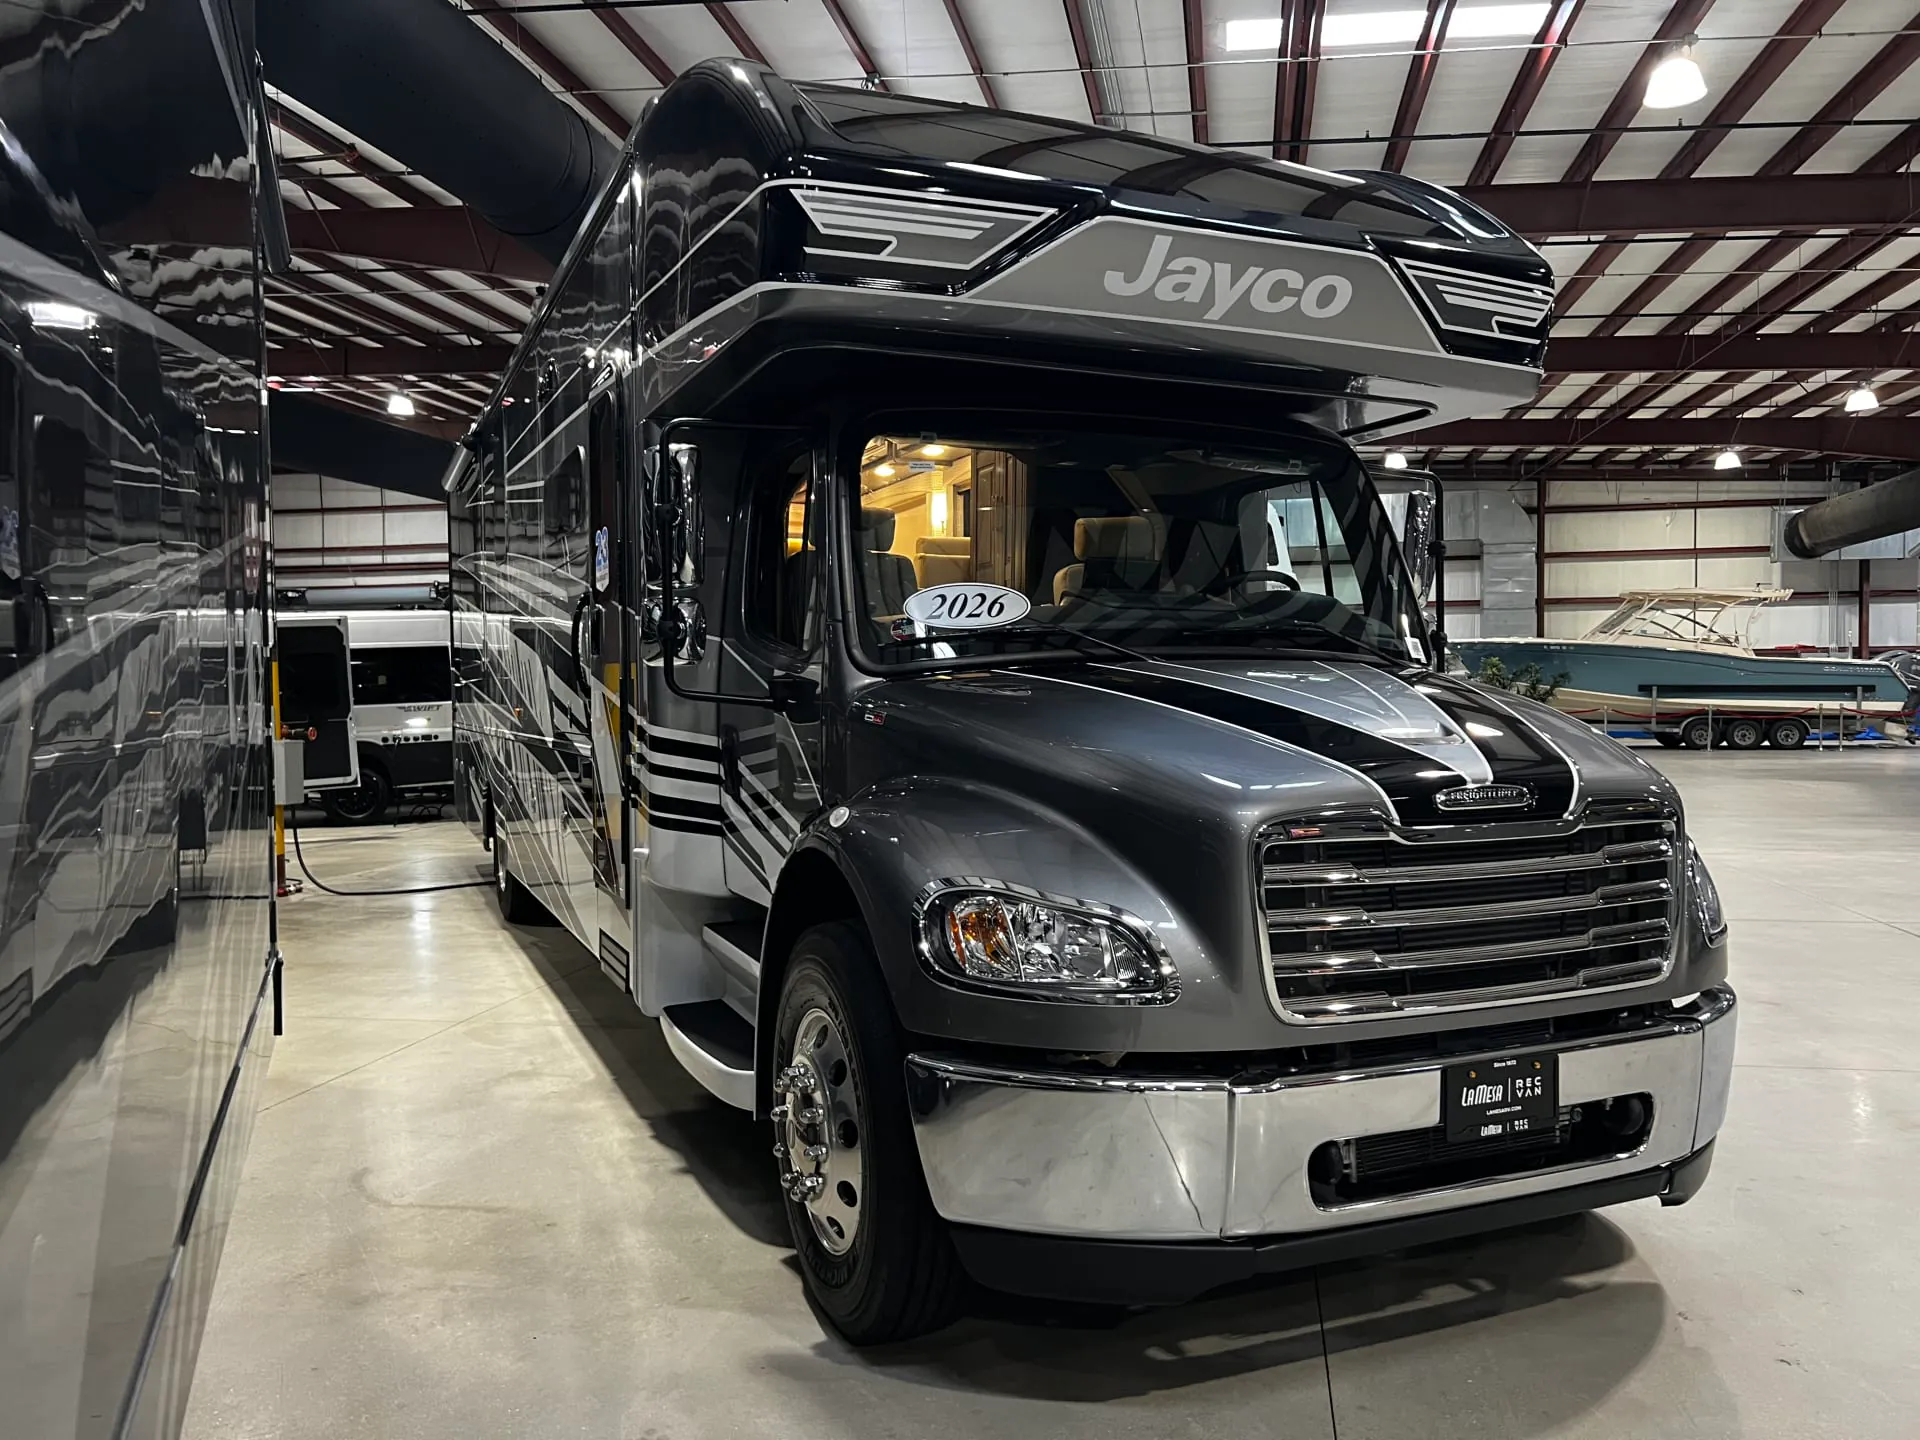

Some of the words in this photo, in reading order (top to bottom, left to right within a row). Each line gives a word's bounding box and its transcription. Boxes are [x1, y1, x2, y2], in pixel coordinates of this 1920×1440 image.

[1103, 234, 1353, 320] Jayco
[926, 592, 1010, 620] 2026
[1515, 1076, 1542, 1089] REC
[1516, 1086, 1542, 1098] VAN
